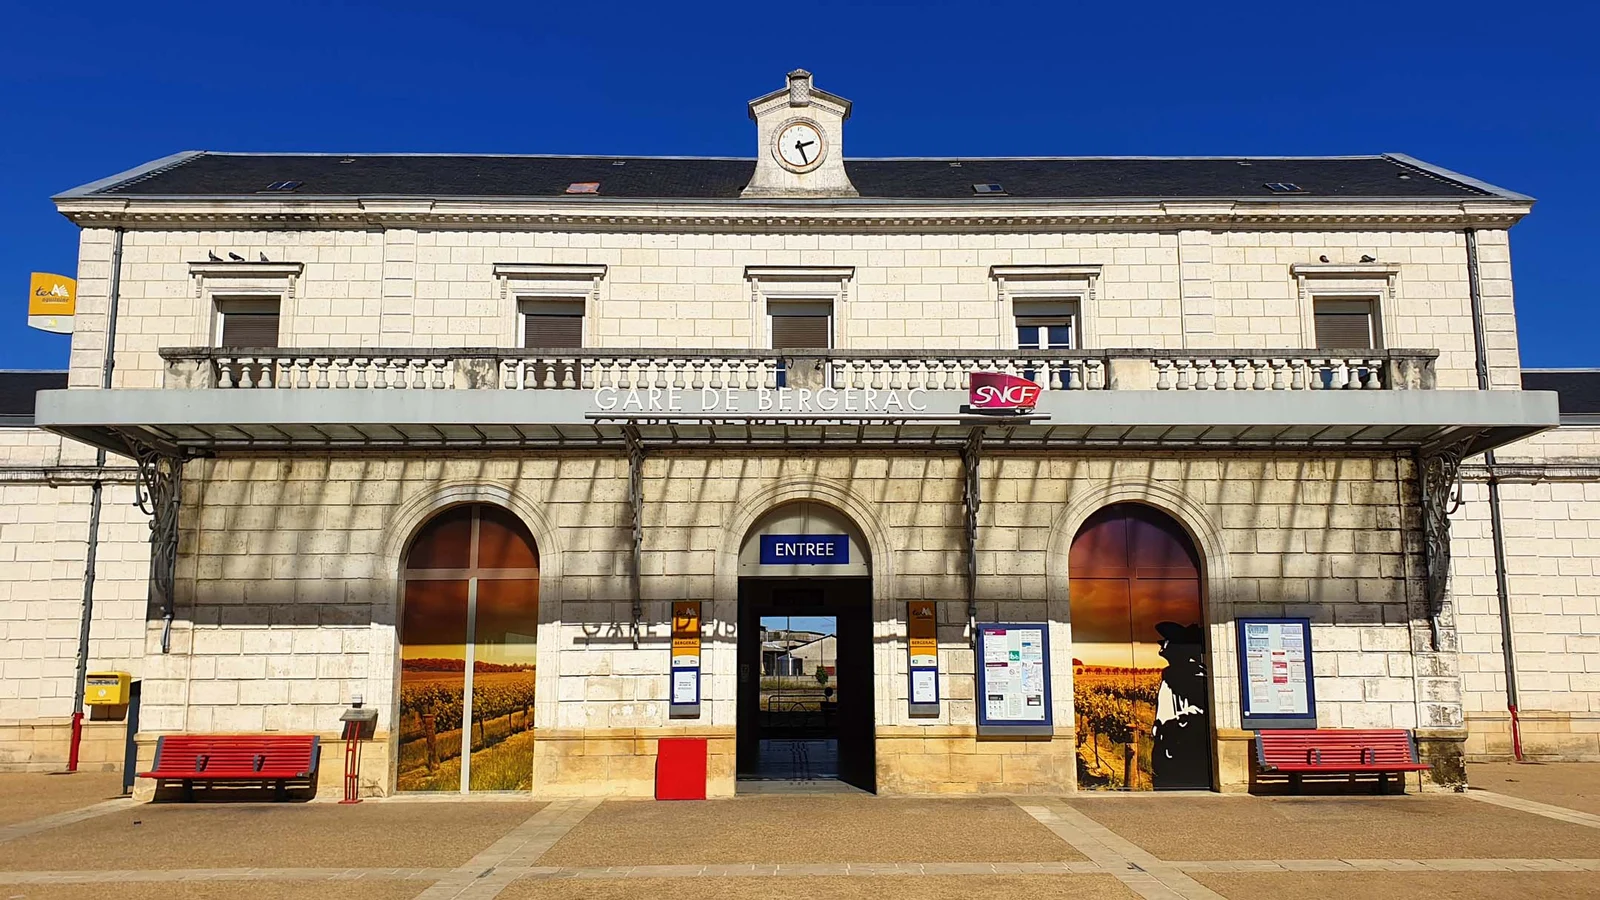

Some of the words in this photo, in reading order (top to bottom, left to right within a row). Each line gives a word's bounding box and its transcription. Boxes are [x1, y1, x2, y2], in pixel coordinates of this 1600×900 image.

[594, 386, 682, 410] GARE
[701, 387, 739, 410] DE
[759, 386, 927, 411] BERGERAC
[974, 385, 1037, 404] SNCF
[775, 543, 834, 556] ENTREE
